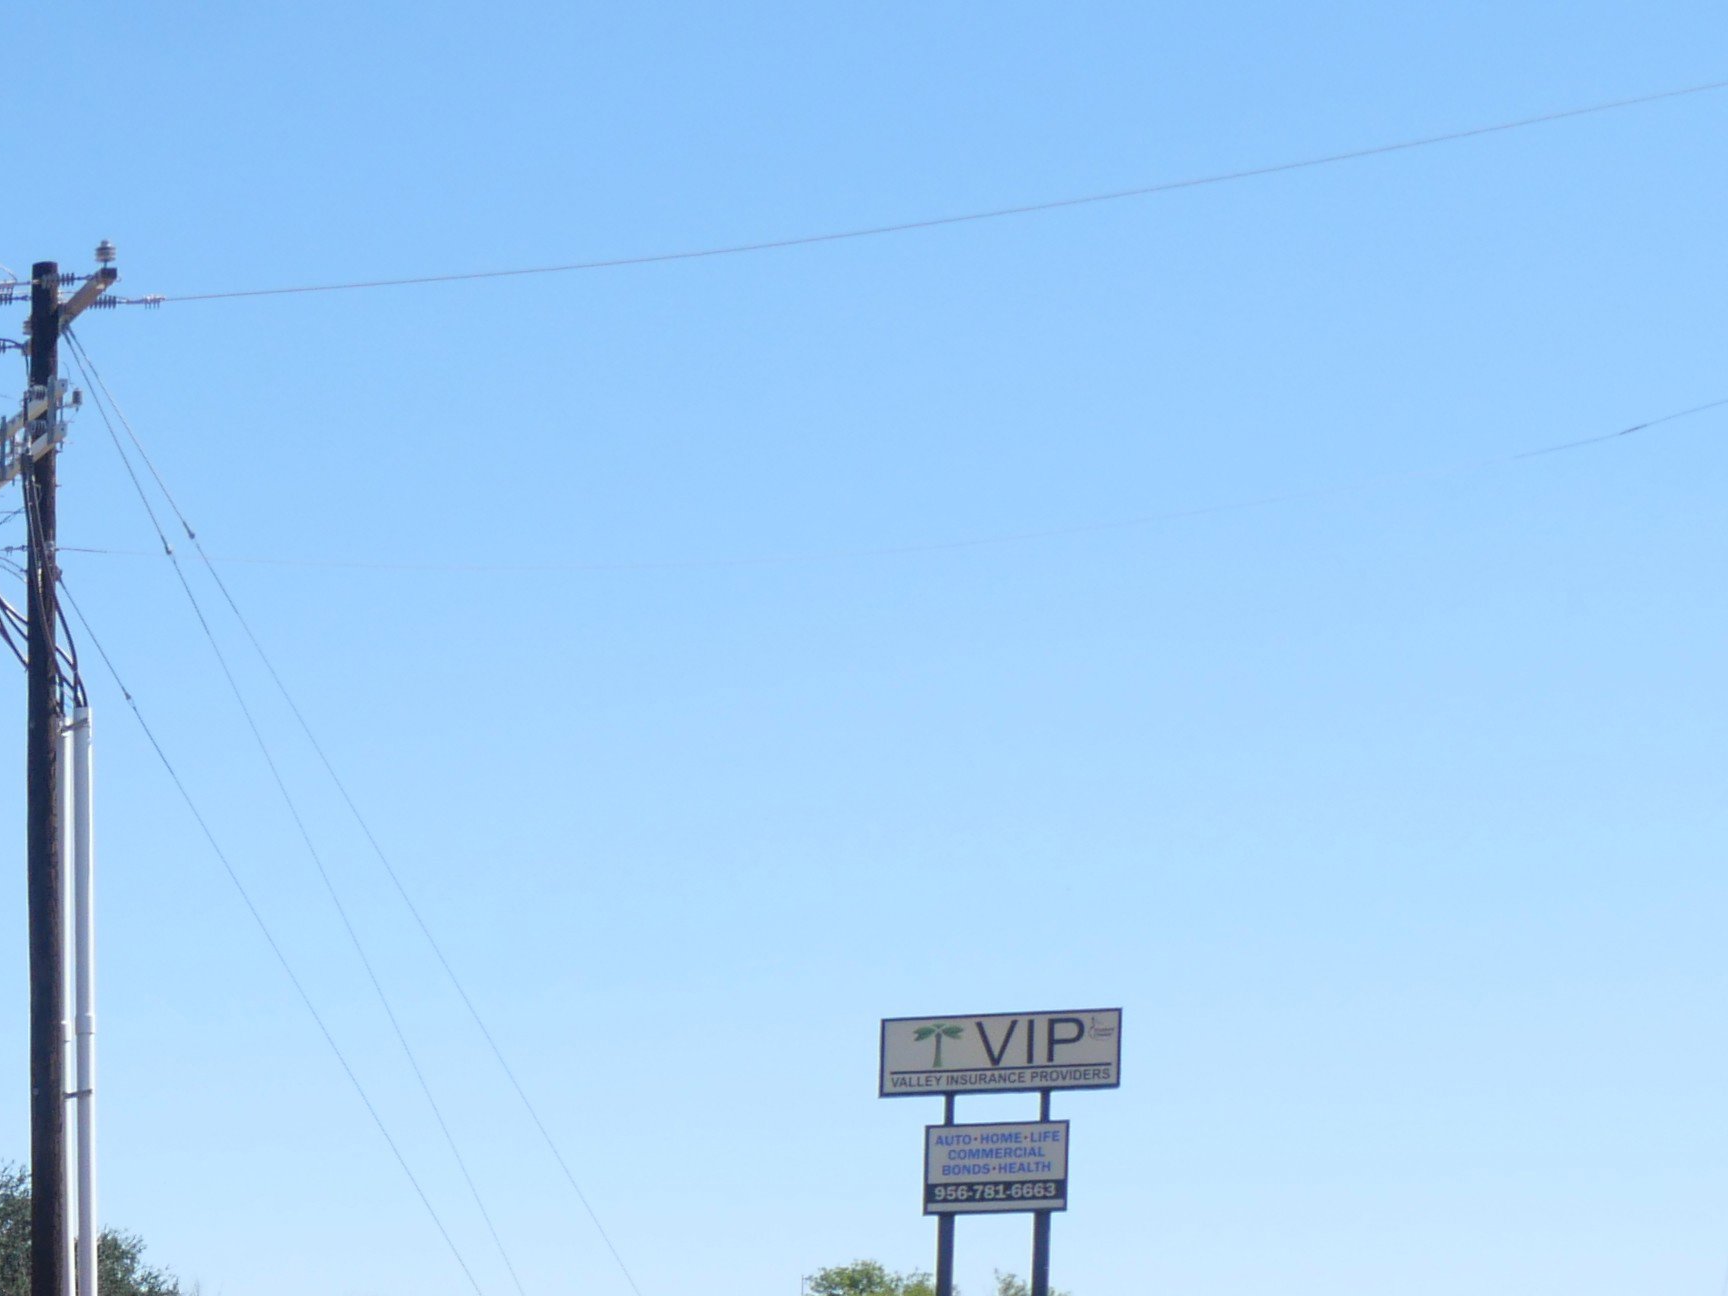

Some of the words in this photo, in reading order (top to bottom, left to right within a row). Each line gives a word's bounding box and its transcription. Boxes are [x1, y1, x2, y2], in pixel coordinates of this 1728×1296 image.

[975, 1017, 1086, 1066] VIP
[891, 1075, 943, 1088] VALLEY
[946, 1071, 1026, 1086] INSURANCE
[1030, 1068, 1111, 1083] PROVIDERS
[936, 1134, 972, 1146] AUTO
[980, 1132, 1023, 1144] HOME
[1030, 1130, 1060, 1143] LIFE
[947, 1146, 1045, 1160] COMMERCIAL
[941, 1163, 990, 1176] BONDS
[998, 1161, 1052, 1174] HEALTH
[934, 1182, 1057, 1200] 956-781-6663
